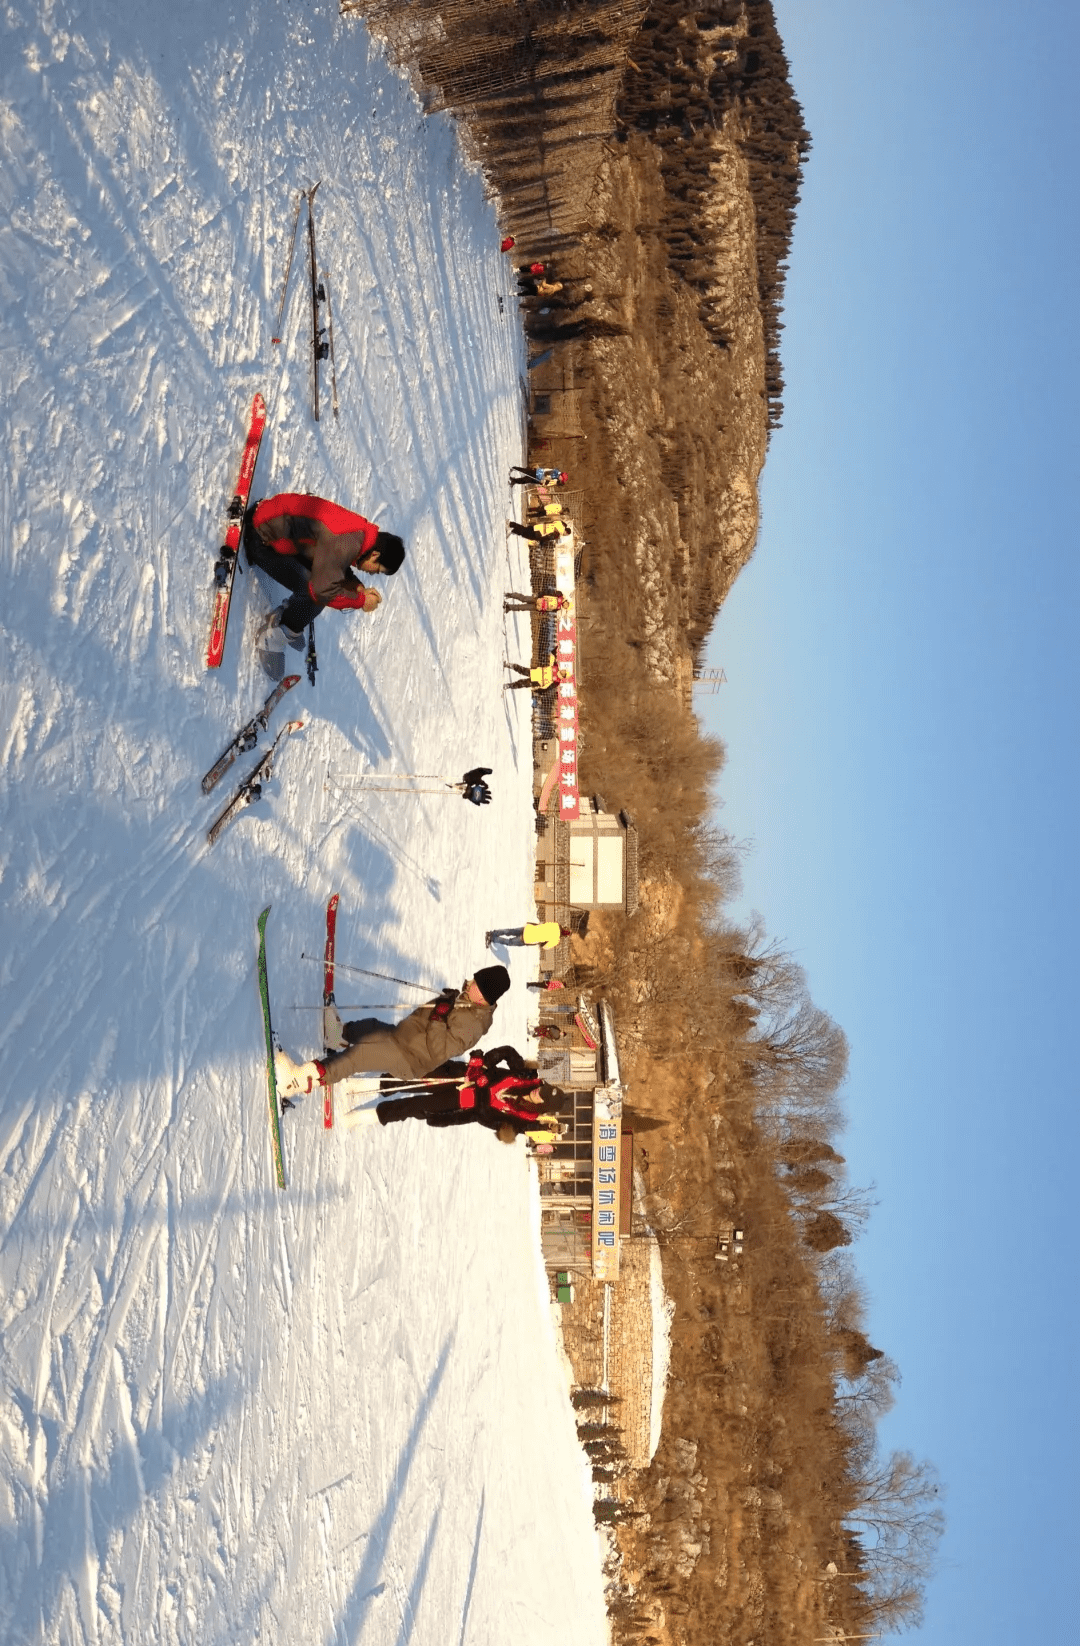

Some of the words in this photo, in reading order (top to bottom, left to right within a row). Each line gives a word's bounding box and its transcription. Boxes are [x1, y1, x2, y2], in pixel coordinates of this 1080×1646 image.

[597, 1123, 617, 1247] 滑雪场休闲吧
